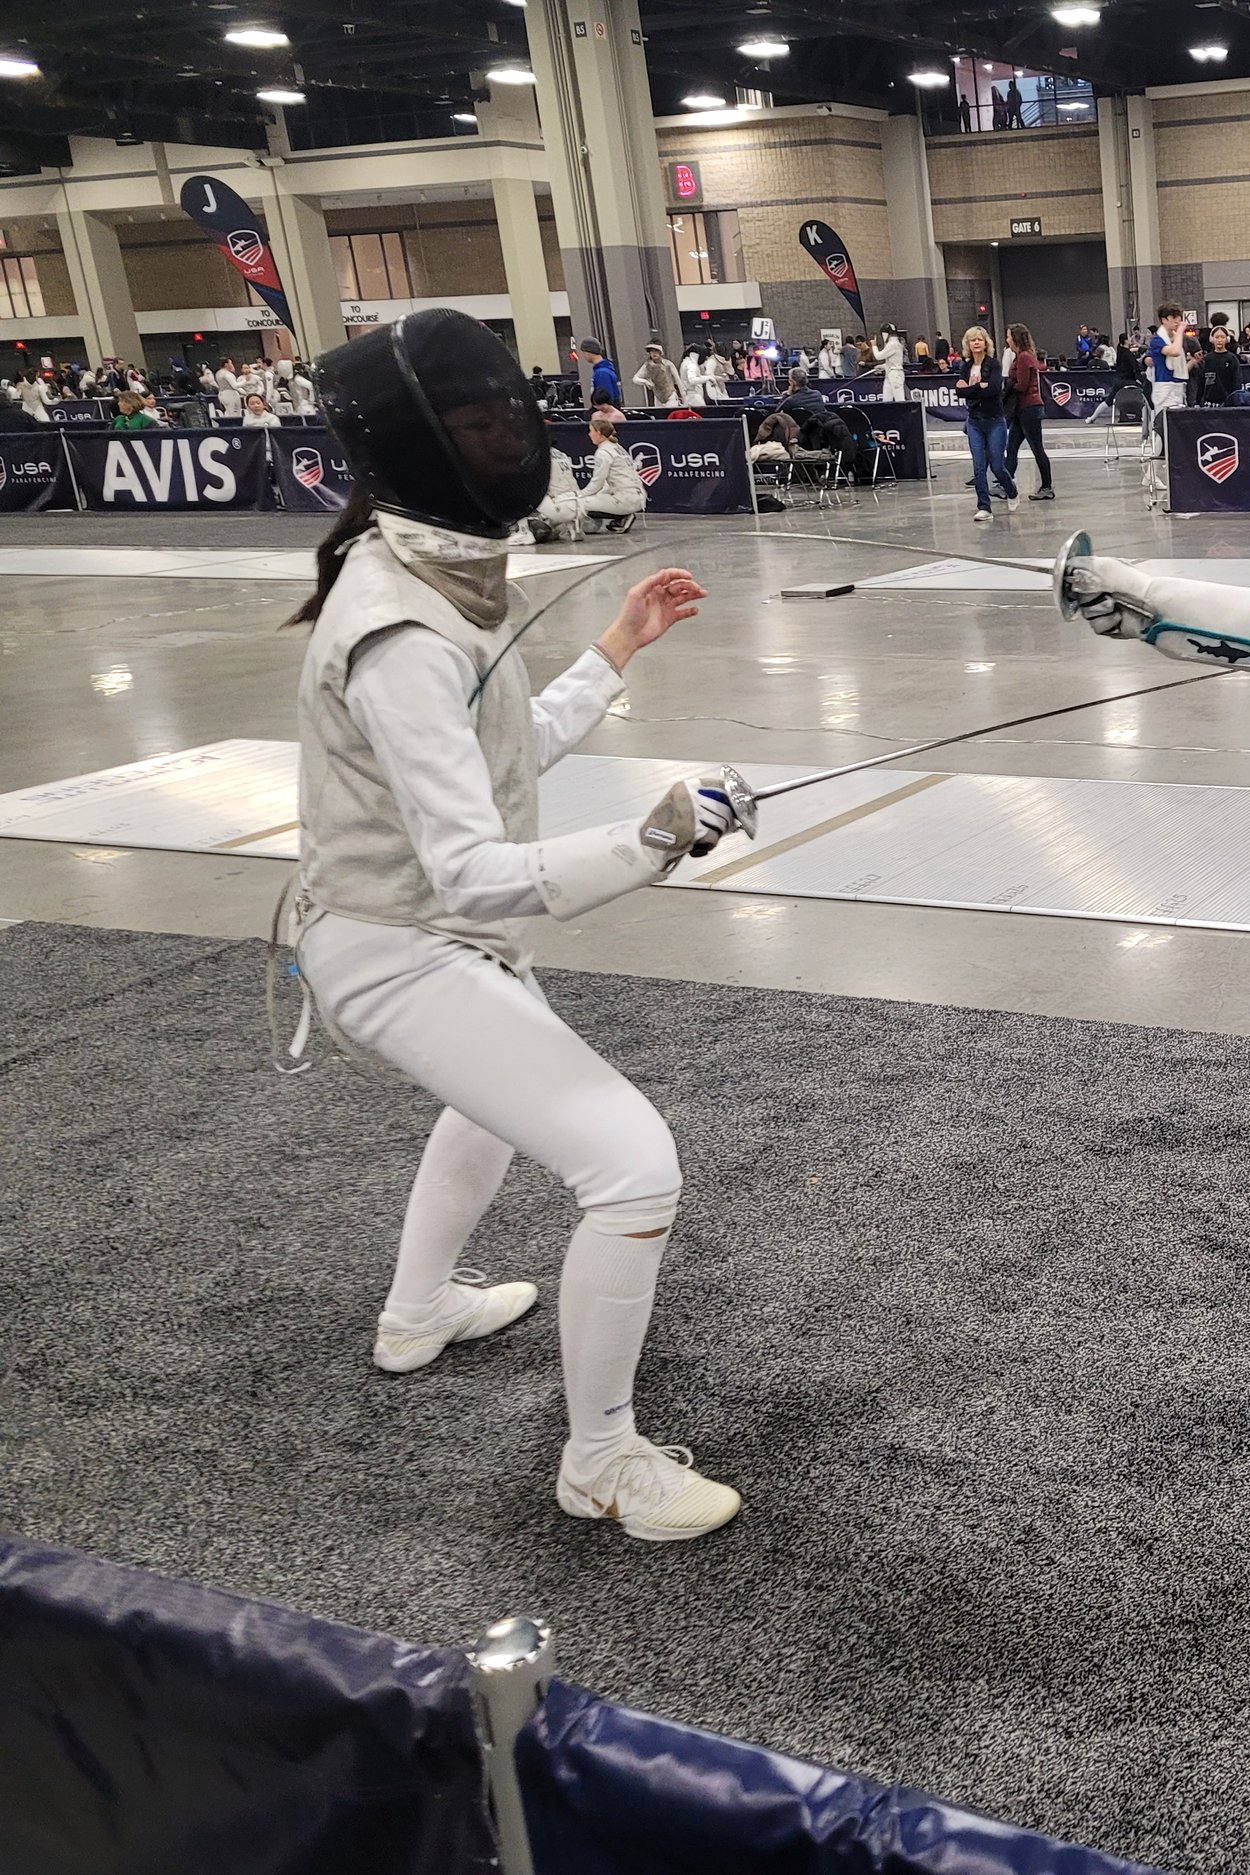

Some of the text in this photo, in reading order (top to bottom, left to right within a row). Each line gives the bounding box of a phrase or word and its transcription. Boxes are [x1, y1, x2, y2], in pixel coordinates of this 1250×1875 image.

[675, 164, 696, 198] B
[202, 184, 217, 212] J
[806, 225, 823, 245] K
[1012, 222, 1040, 233] GATE 6
[754, 321, 764, 337] J
[1076, 388, 1106, 396] USA
[12, 462, 52, 475] USA
[671, 453, 720, 468] USA
[103, 437, 237, 502] AVIS
